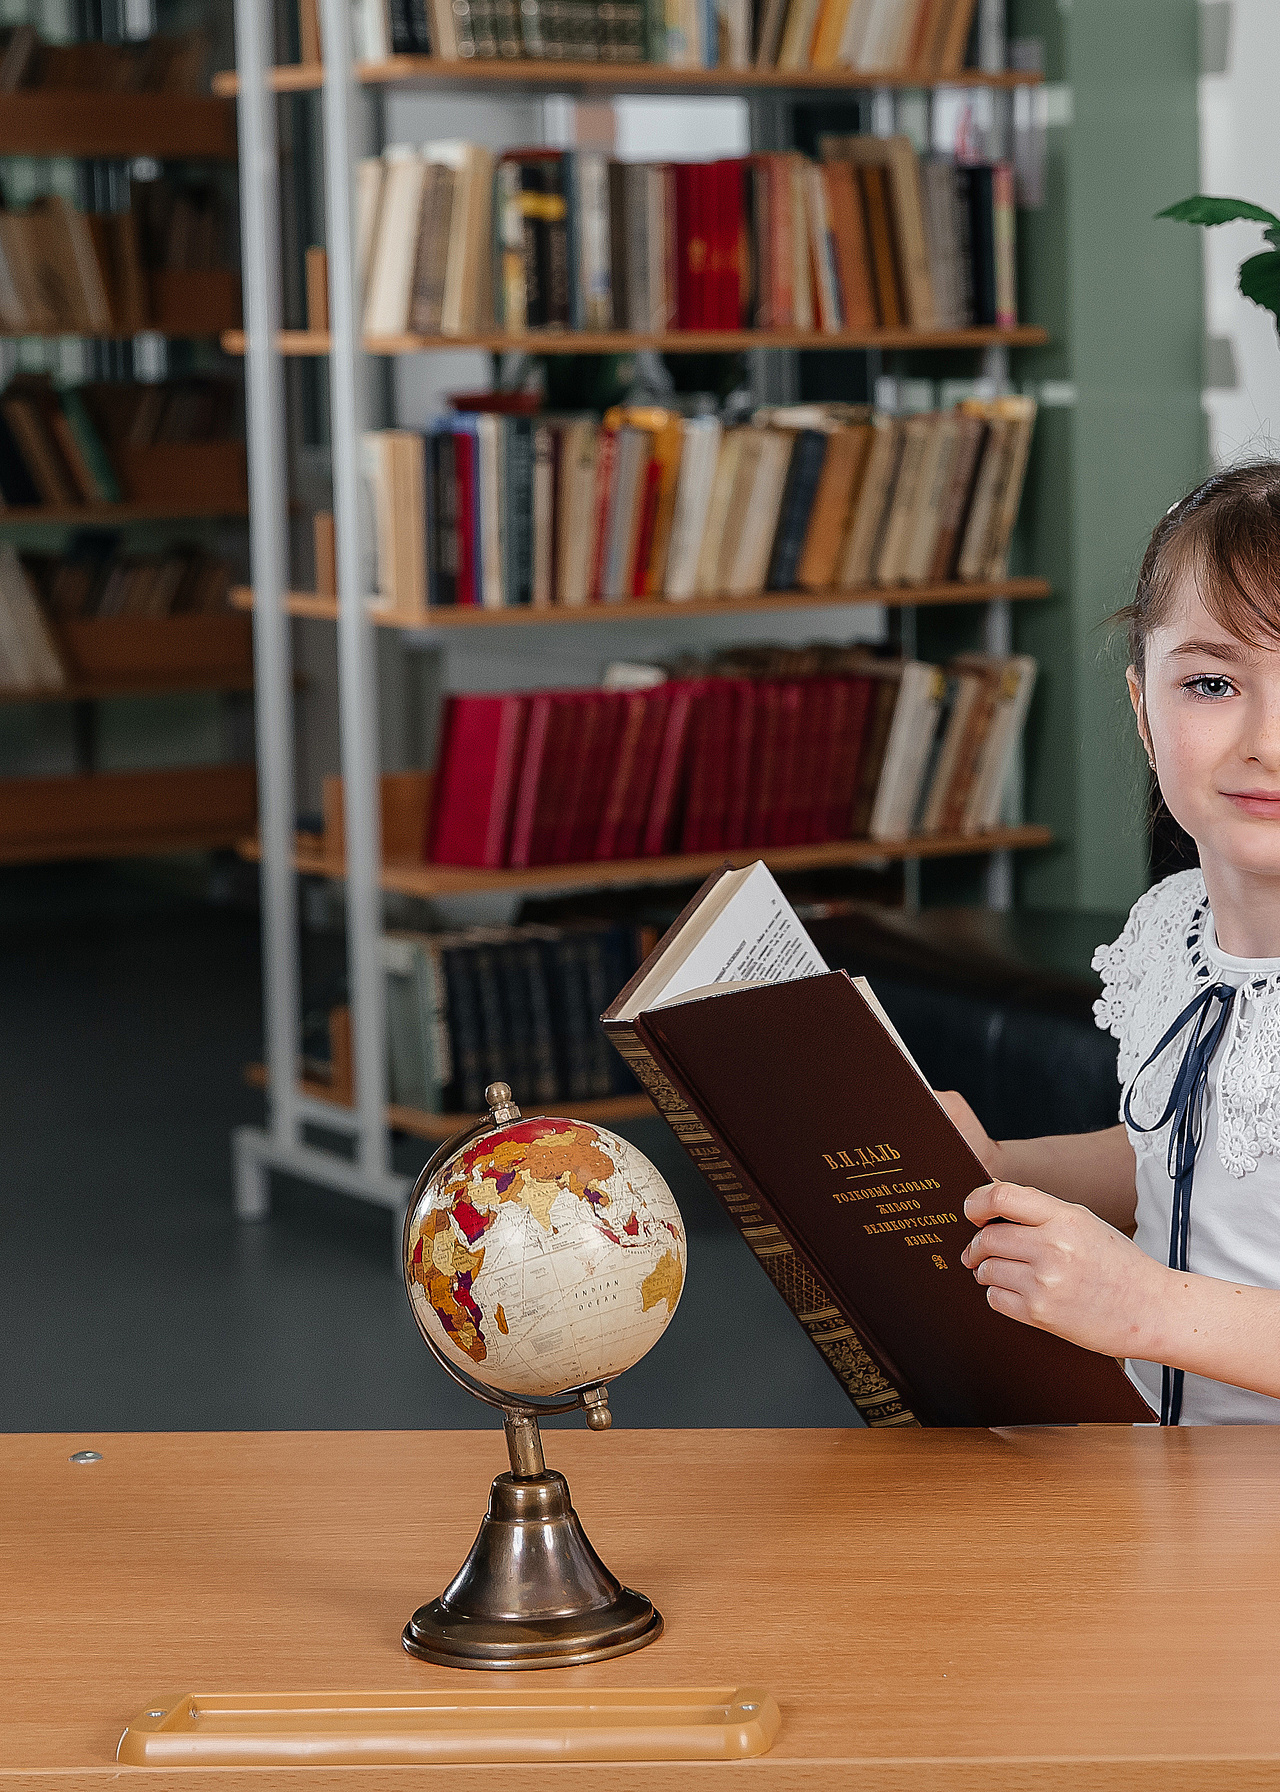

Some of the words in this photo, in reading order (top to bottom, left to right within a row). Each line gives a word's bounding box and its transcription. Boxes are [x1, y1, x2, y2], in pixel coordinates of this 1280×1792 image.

[832, 1184, 893, 1204] ТОЛКОВЫЙ
[892, 1178, 941, 1194] СЛОВАРЬ
[876, 1199, 921, 1215] ЖИВОГО
[863, 1212, 958, 1235] ВЕЛИКОРУССКОГО
[904, 1233, 943, 1247] ЯЗЫКА
